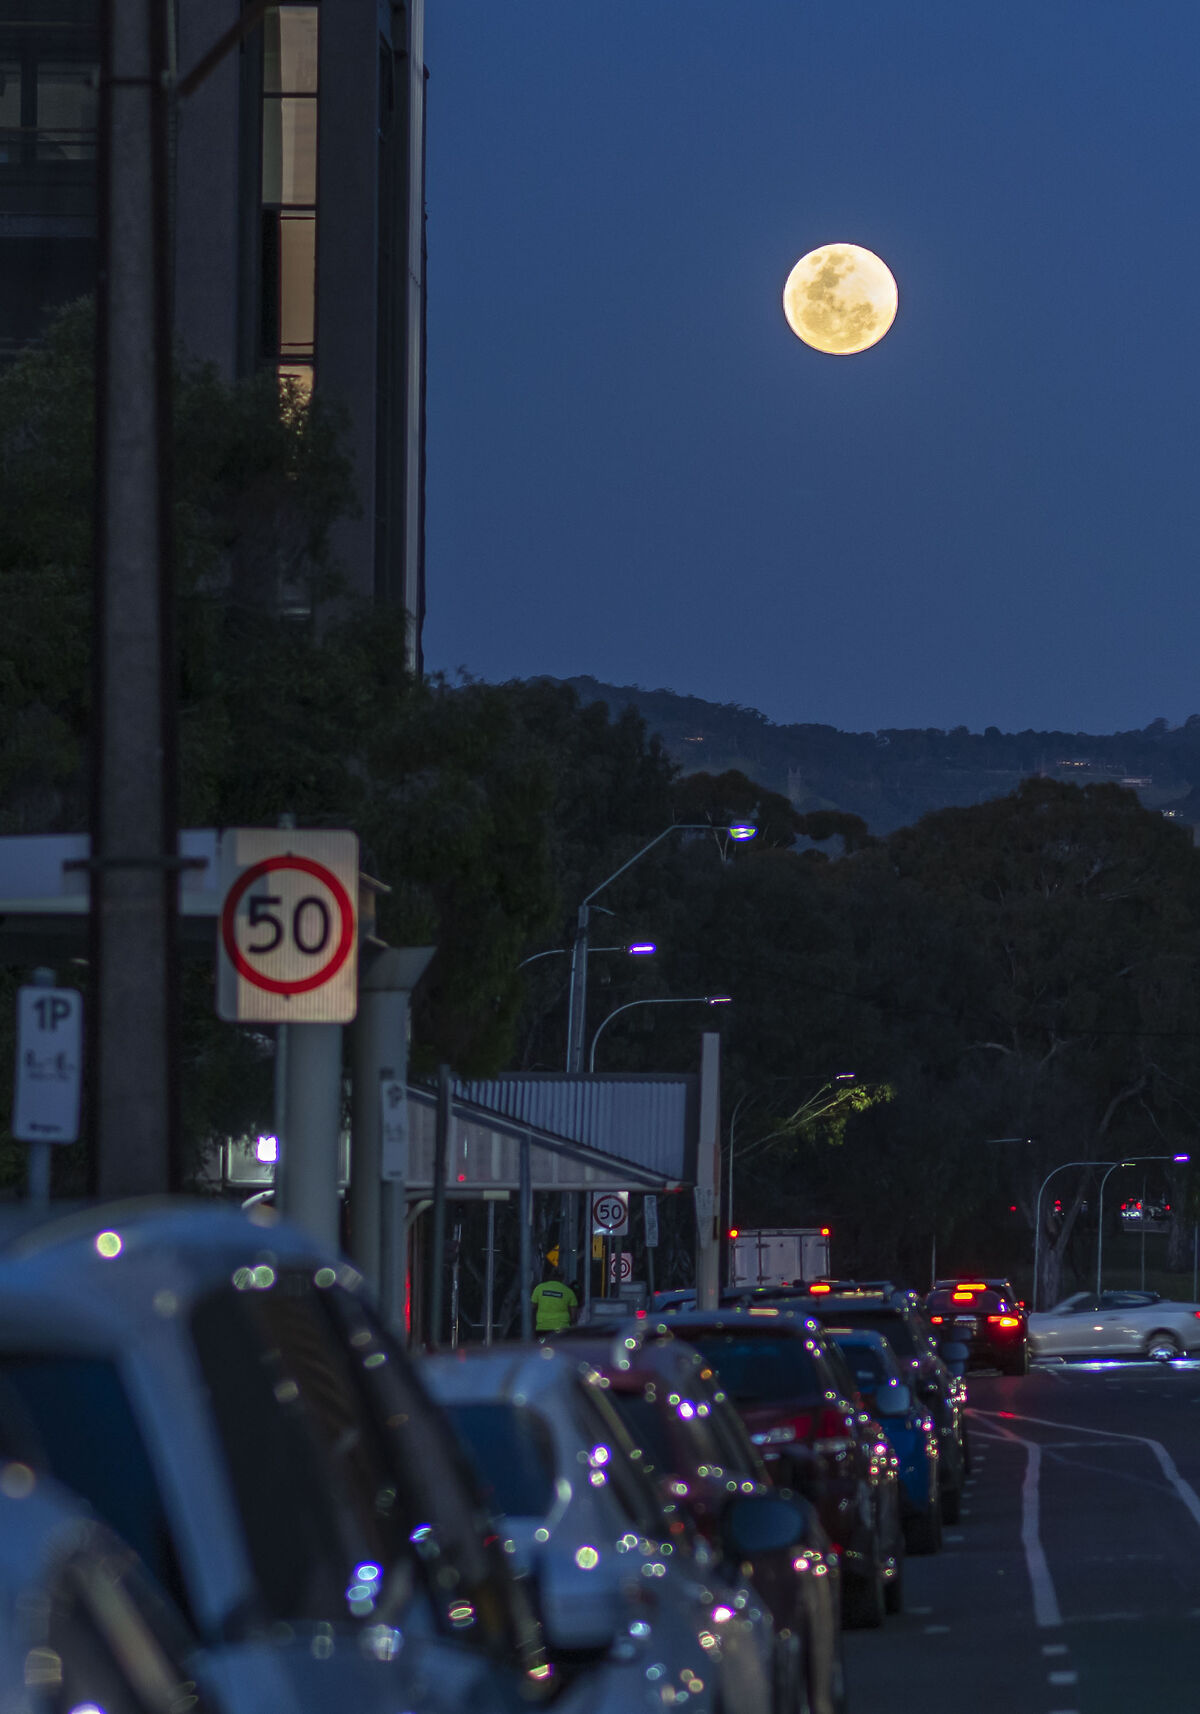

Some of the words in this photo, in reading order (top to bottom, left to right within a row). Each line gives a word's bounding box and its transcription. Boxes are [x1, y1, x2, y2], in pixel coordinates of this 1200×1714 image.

[247, 896, 330, 955] 50
[34, 996, 71, 1031] 1P
[599, 1204, 622, 1220] 50
